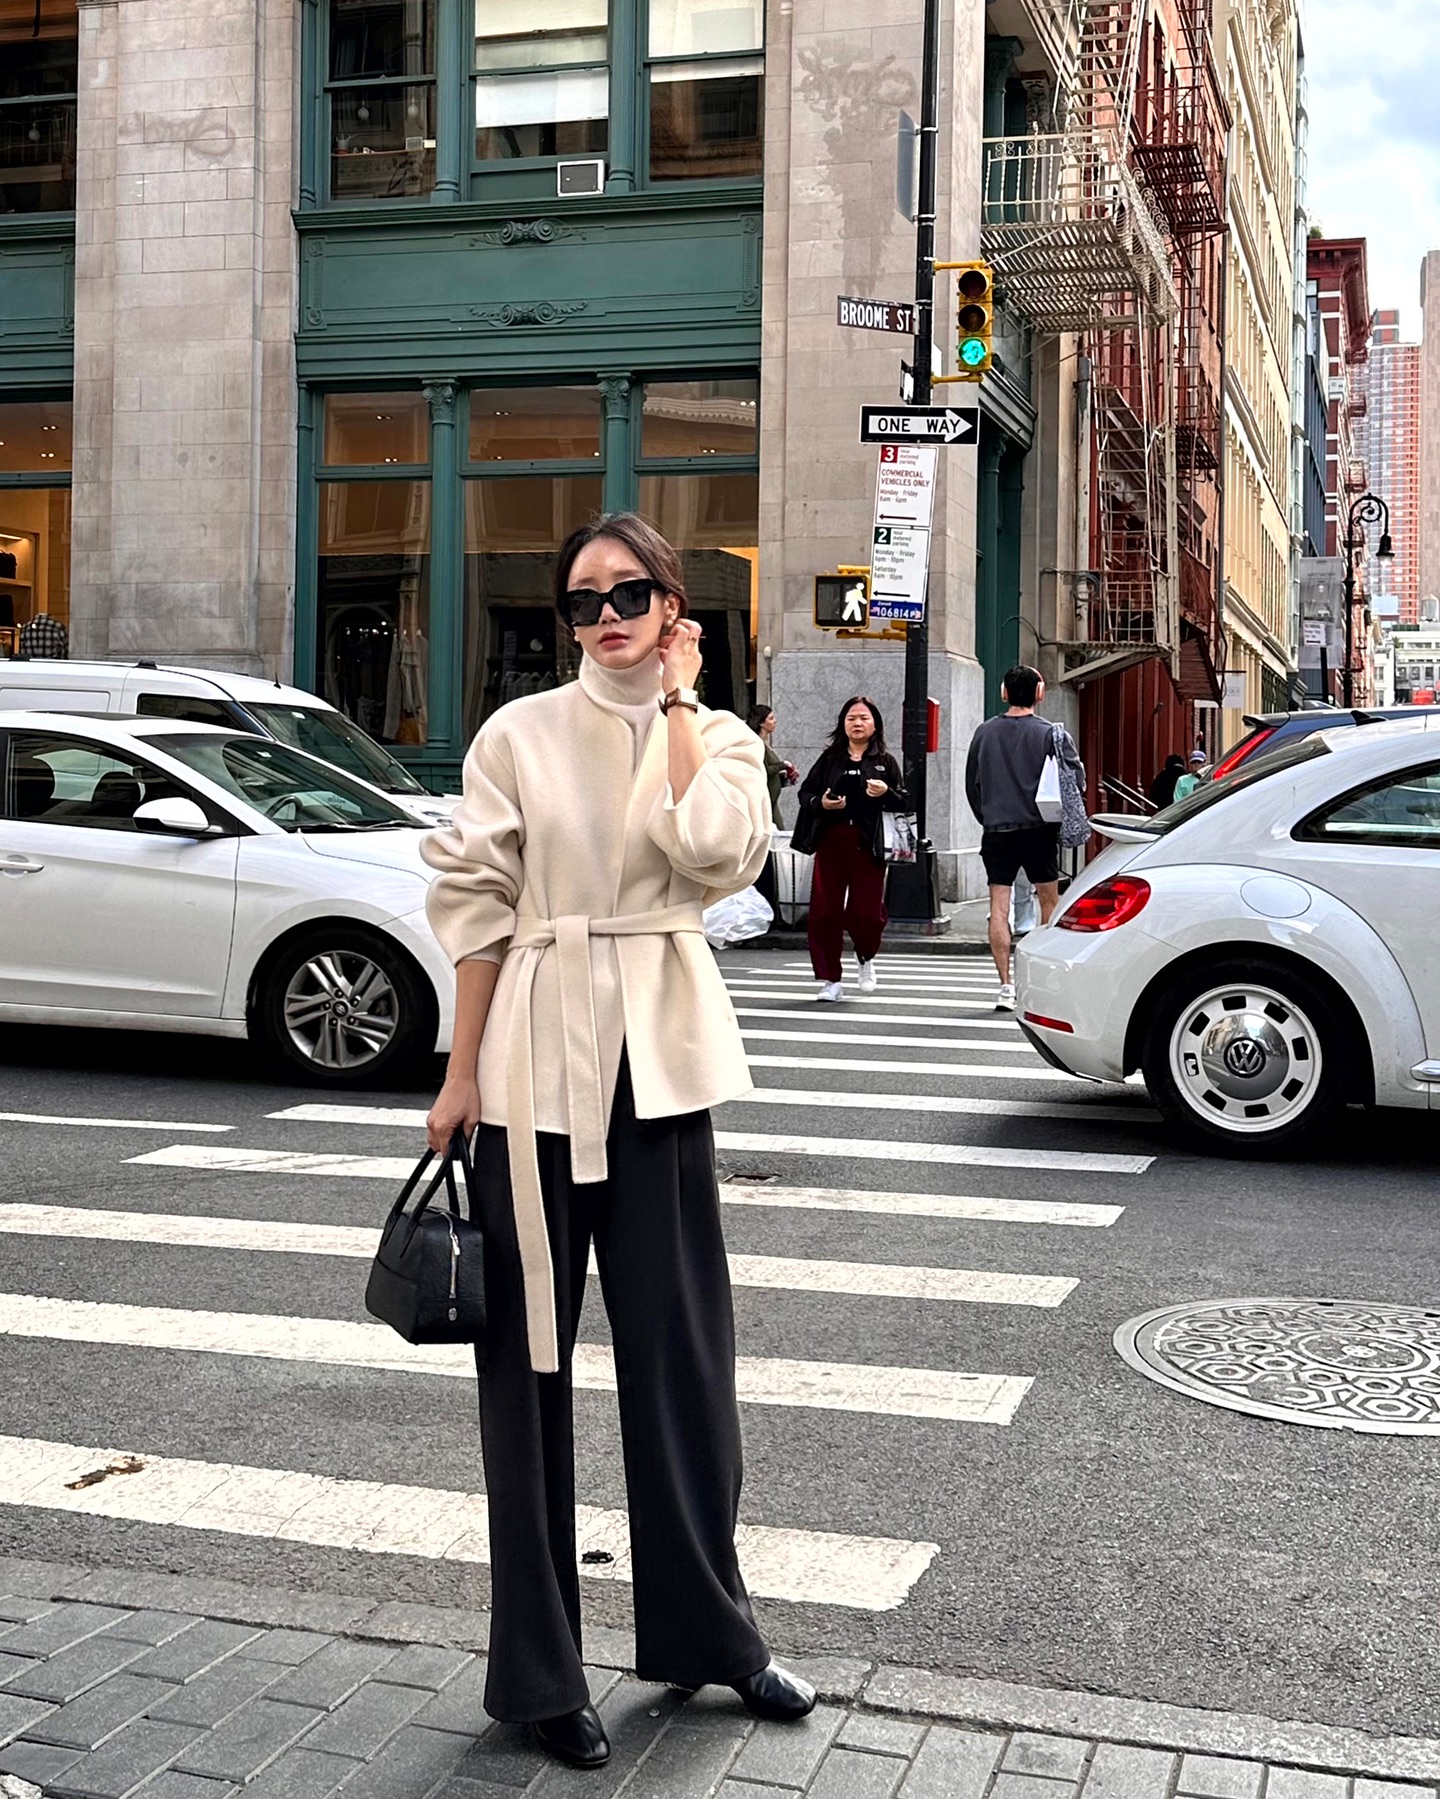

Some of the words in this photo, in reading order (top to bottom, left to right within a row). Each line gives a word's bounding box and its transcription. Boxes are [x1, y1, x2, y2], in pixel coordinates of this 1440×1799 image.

[840, 301, 890, 329] BROOME
[896, 308, 911, 332] ST
[878, 417, 911, 433] ONE
[926, 418, 961, 433] WAY
[884, 446, 895, 462] 3
[881, 469, 923, 478] COMMERCIAL
[881, 478, 912, 487] VEHICLES
[913, 479, 930, 487] ONLY
[880, 488, 898, 496] Monday
[902, 489, 918, 497] Friday
[877, 528, 888, 543] 2
[899, 550, 915, 558] Friday
[874, 565, 897, 573] Saturday
[877, 606, 909, 619] 106814
